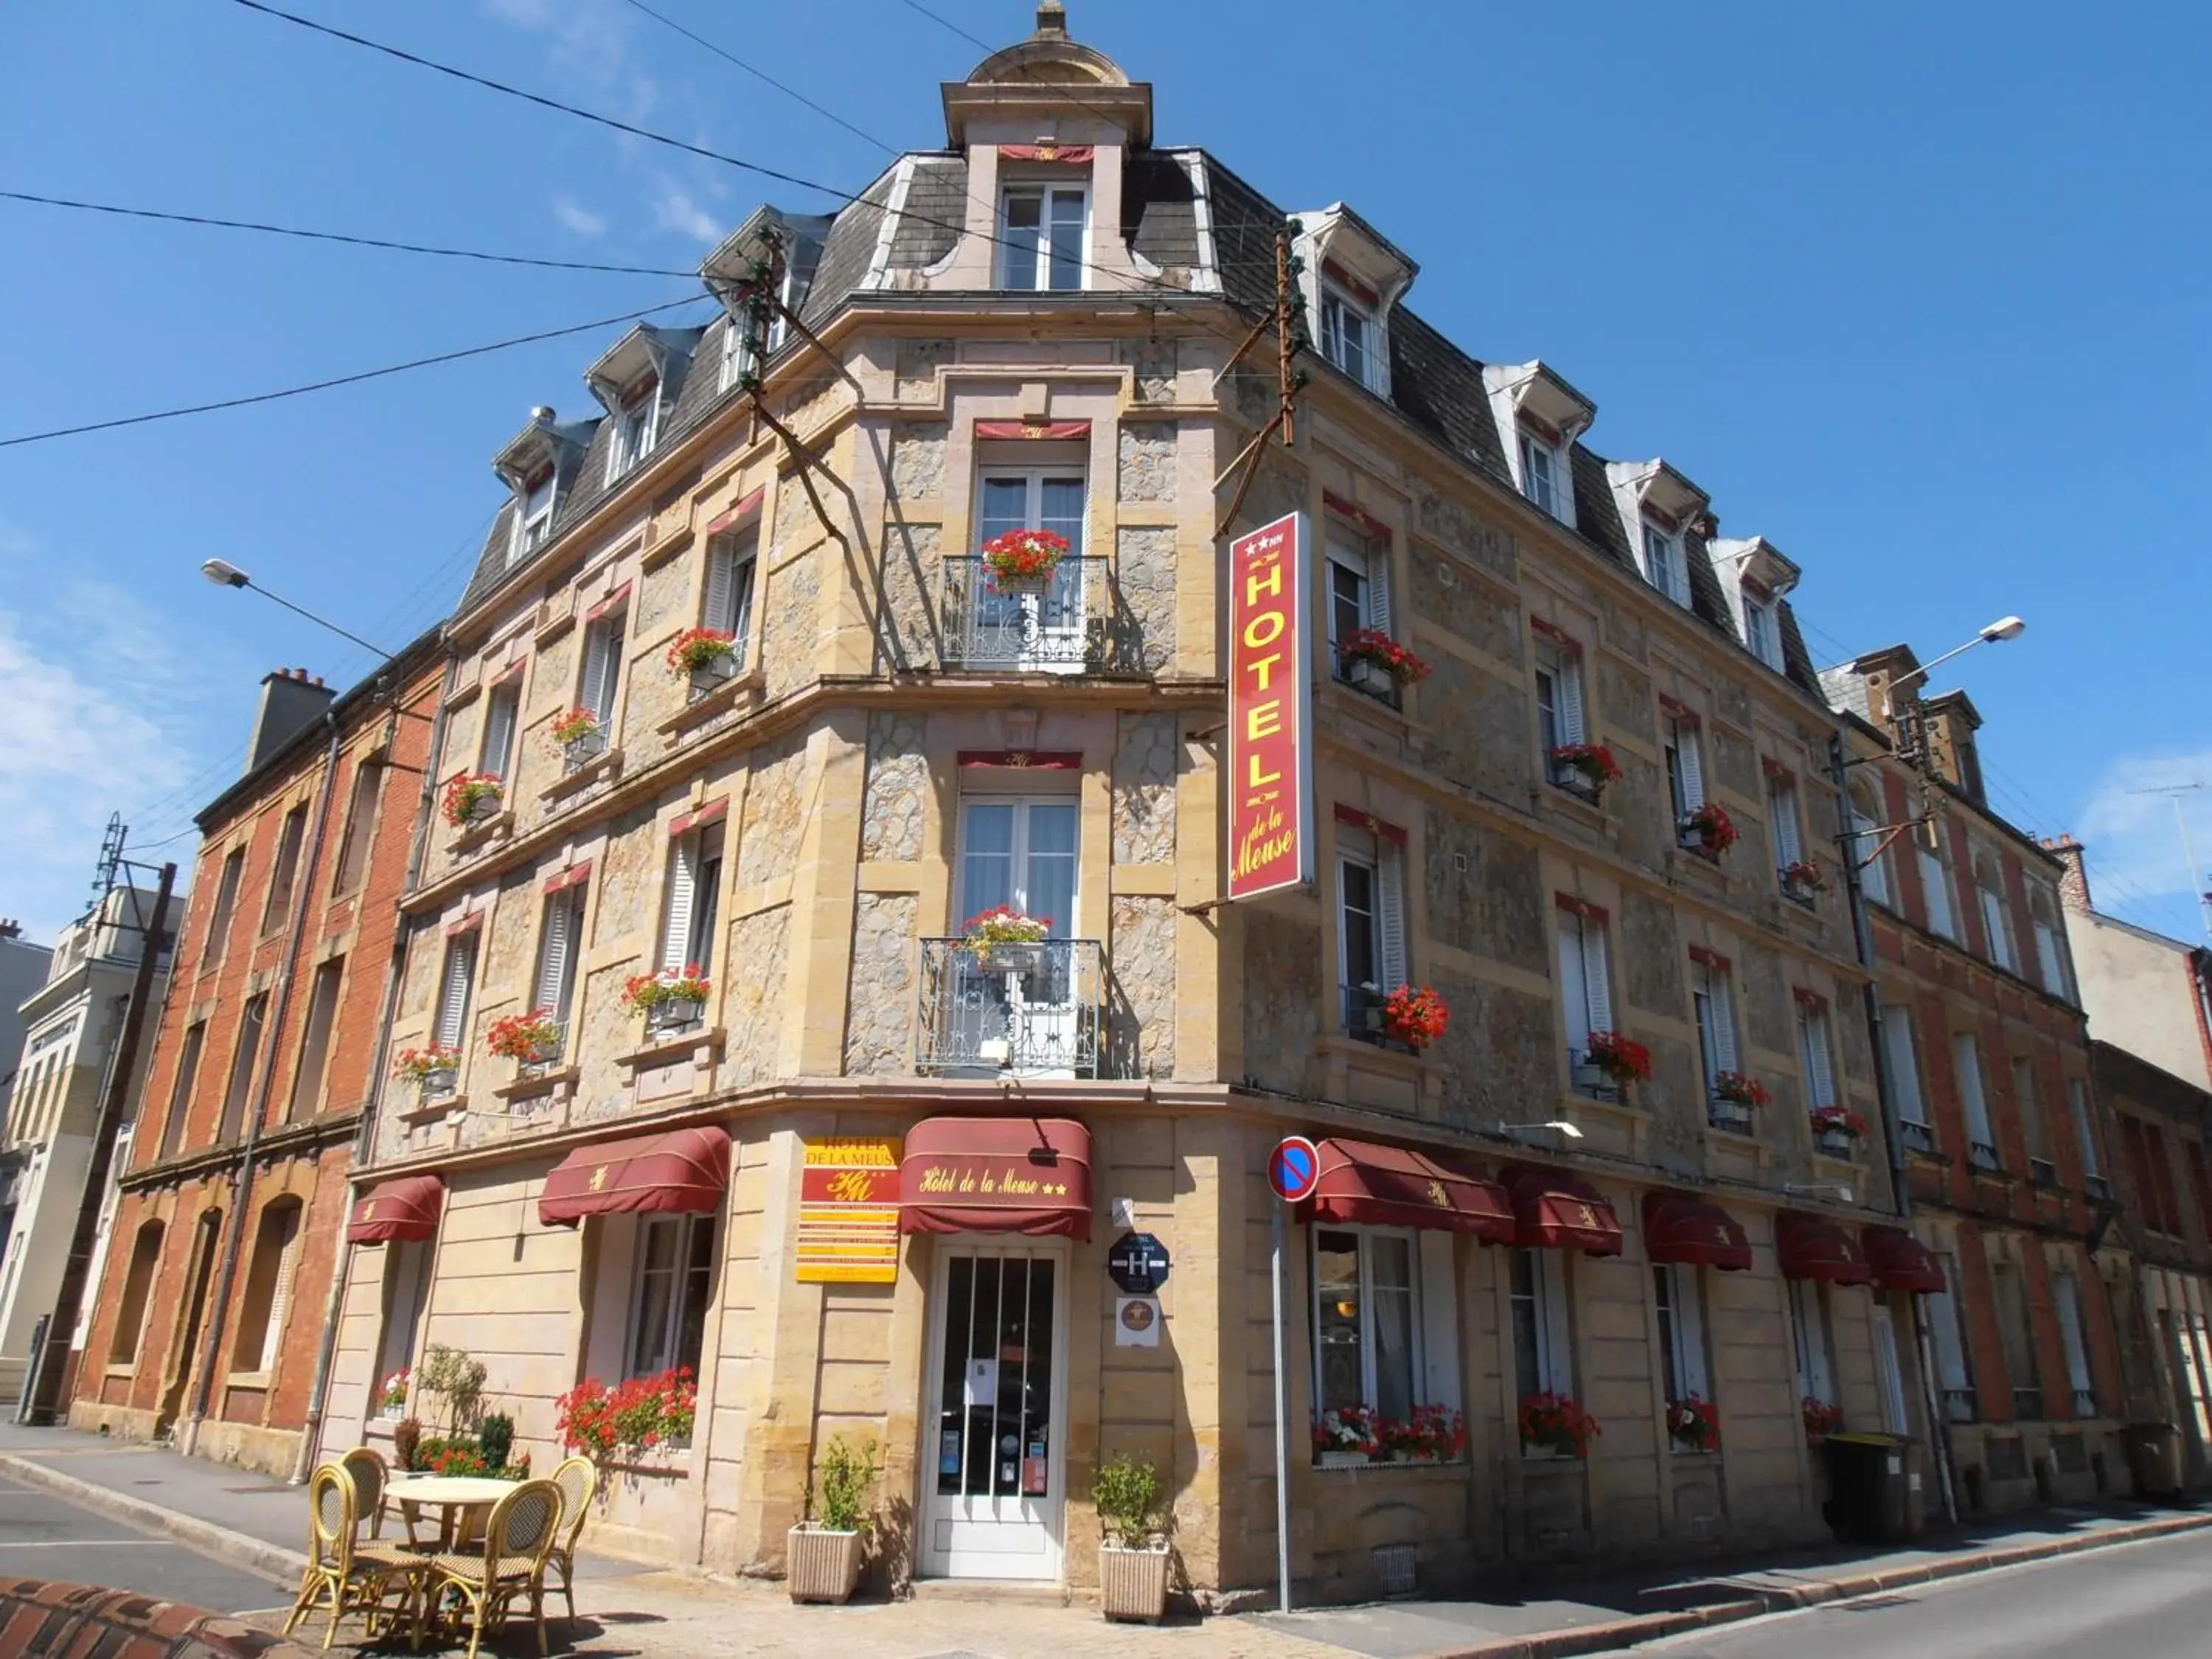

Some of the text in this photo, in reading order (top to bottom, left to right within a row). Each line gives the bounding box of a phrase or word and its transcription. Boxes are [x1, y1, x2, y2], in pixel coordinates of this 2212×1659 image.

[1244, 564, 1285, 788] HOTEL
[1251, 804, 1284, 841] de la
[1231, 829, 1295, 883] Meuse
[824, 1137, 886, 1151] HOTEL
[806, 1152, 825, 1165] DE
[830, 1152, 848, 1165] LA
[959, 1168, 977, 1193] de
[980, 1169, 995, 1193] la
[998, 1168, 1039, 1194] Meuse
[1129, 1252, 1147, 1276] H
